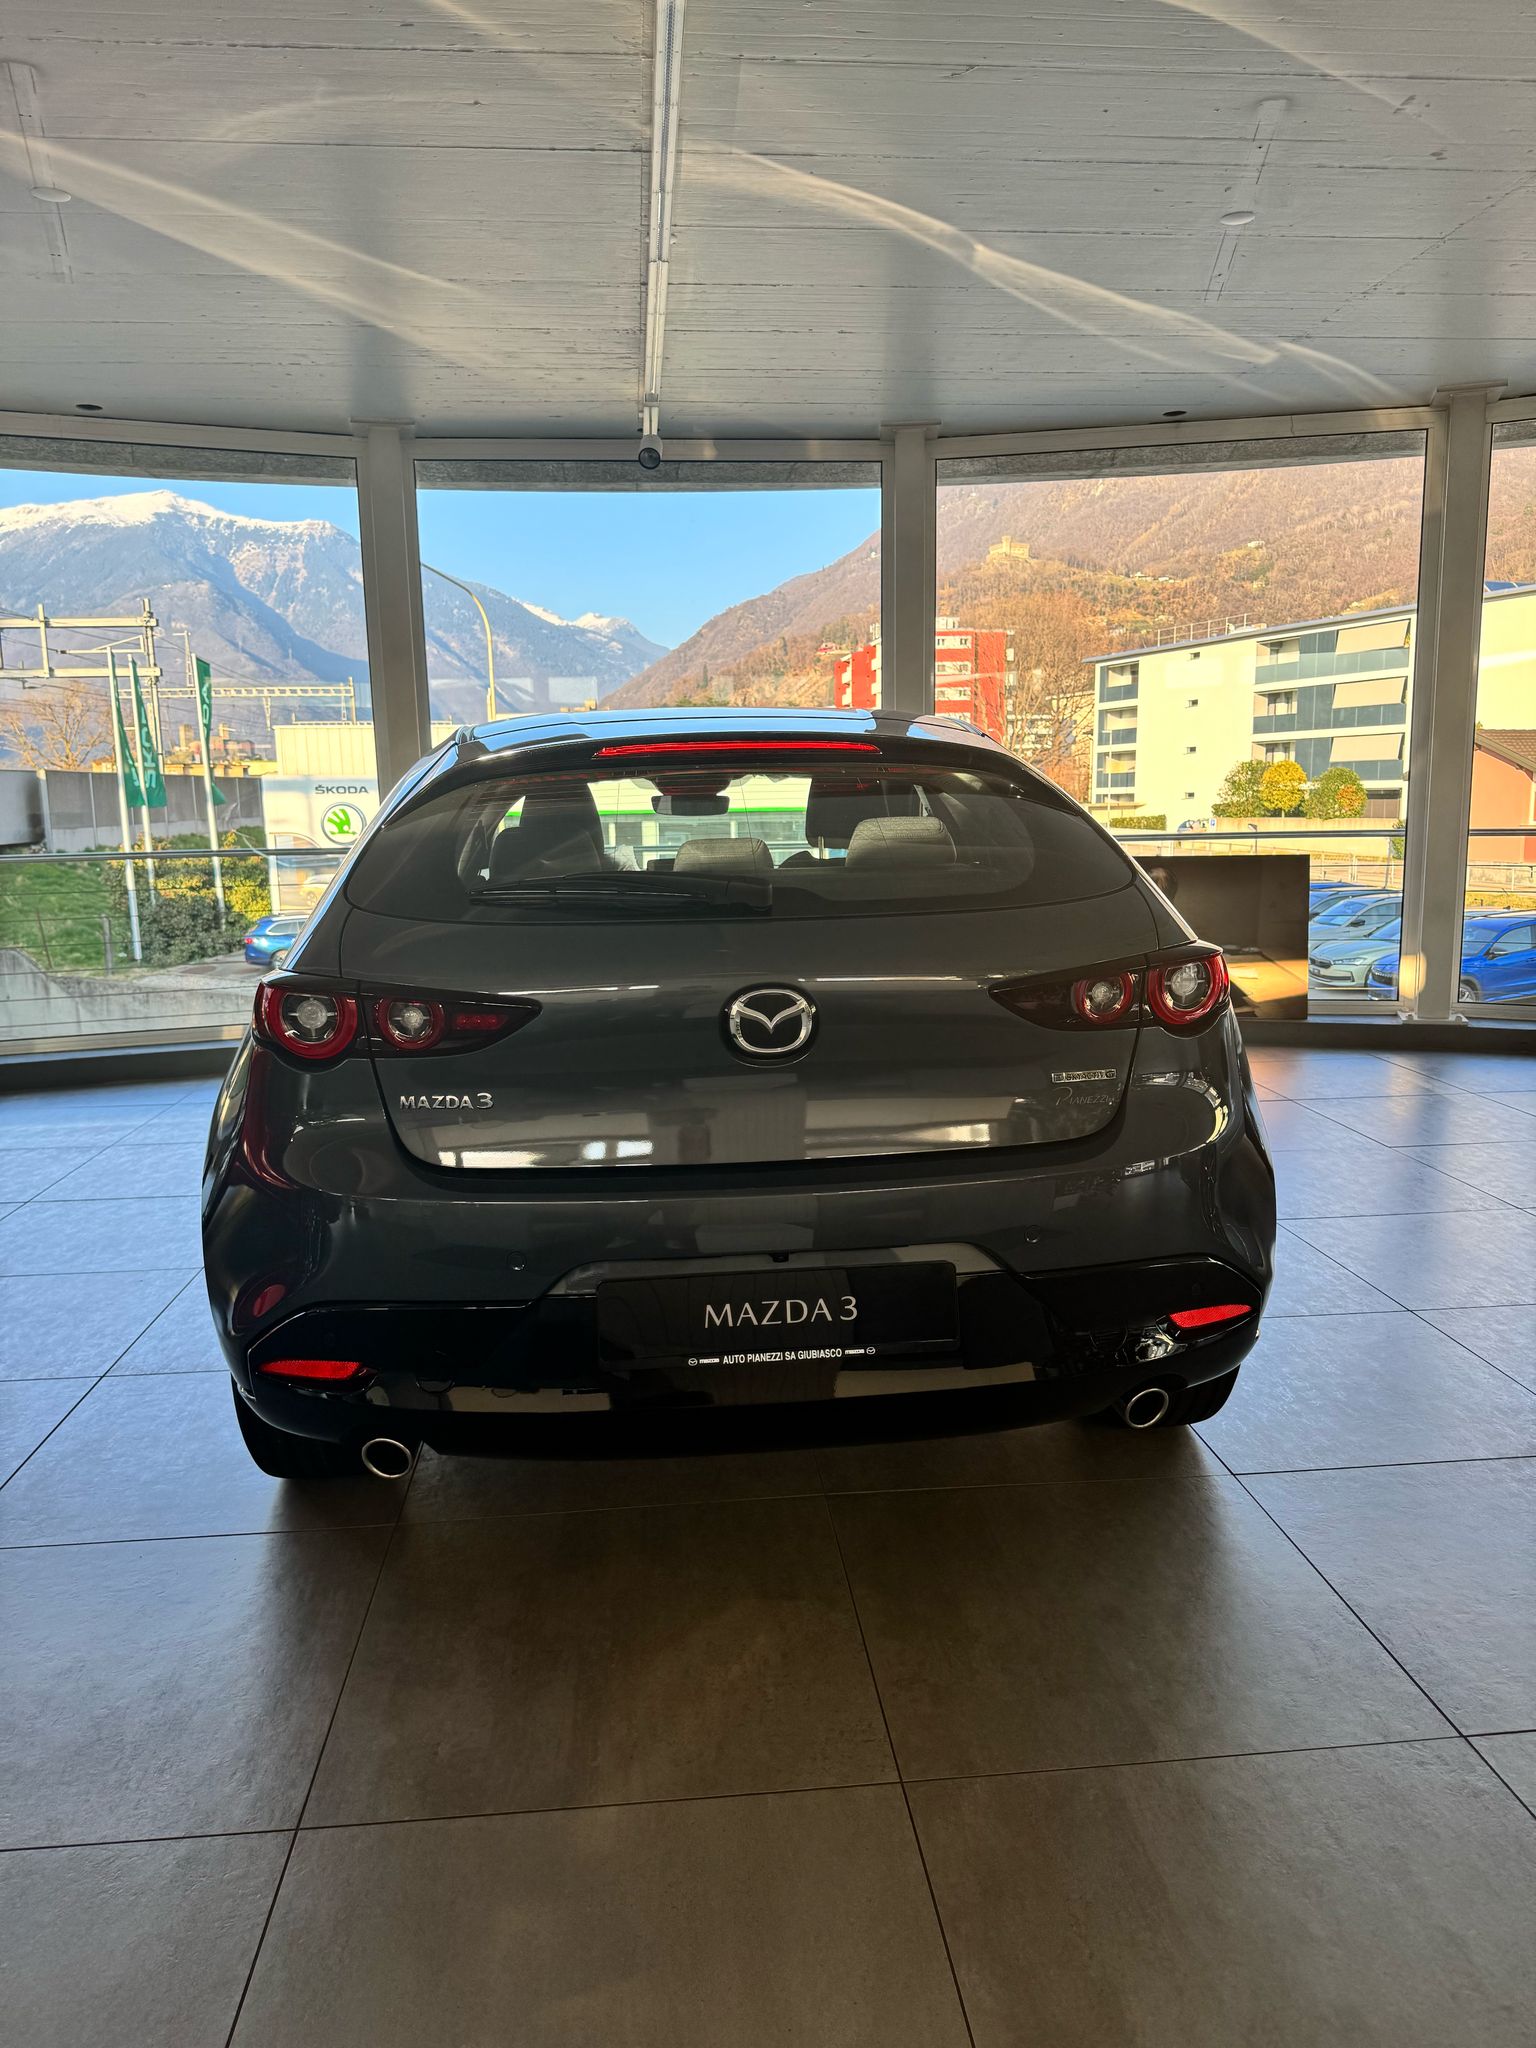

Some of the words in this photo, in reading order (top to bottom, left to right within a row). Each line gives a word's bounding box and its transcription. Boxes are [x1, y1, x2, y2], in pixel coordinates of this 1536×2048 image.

[315, 784, 369, 795] ŠKODA
[399, 1095, 474, 1110] MAZDA
[476, 1092, 494, 1109] 3
[704, 1298, 833, 1329] MAZDA
[840, 1295, 858, 1321] 3
[723, 1354, 746, 1364] AUTO
[747, 1352, 783, 1363] PIANEZZI
[785, 1351, 797, 1361] SA
[798, 1348, 842, 1360] GIUBIASCO
